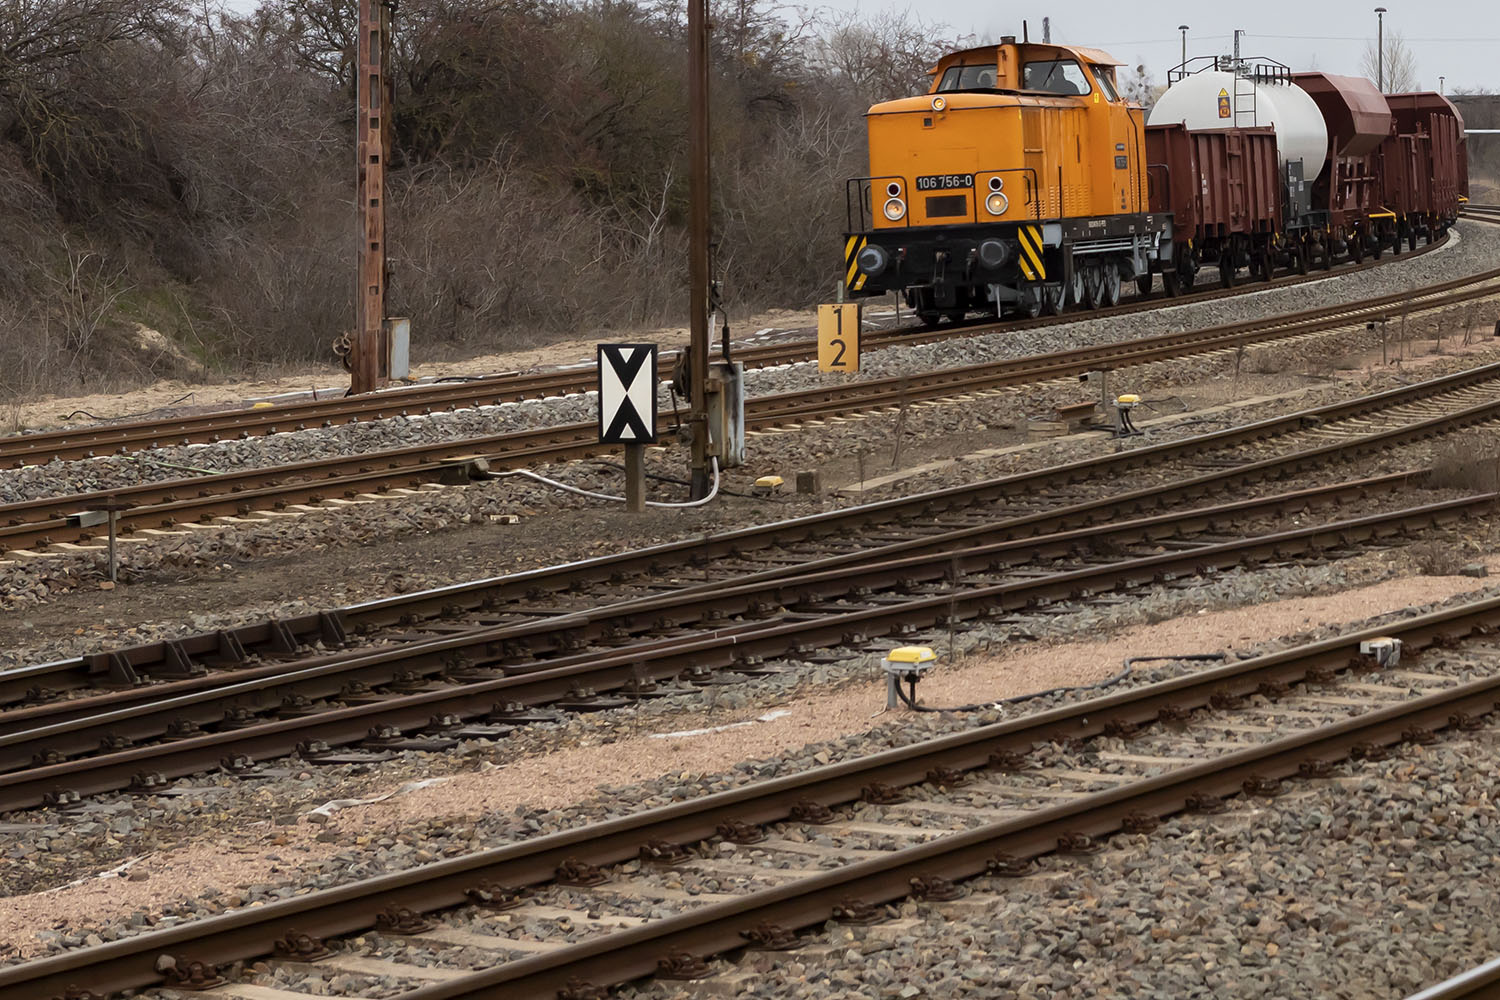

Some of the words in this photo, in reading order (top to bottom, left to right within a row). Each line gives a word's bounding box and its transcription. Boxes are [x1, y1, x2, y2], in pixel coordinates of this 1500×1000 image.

[918, 177, 937, 189] 106
[939, 175, 972, 188] 756-0
[833, 308, 842, 336] 1
[830, 339, 847, 366] 2
